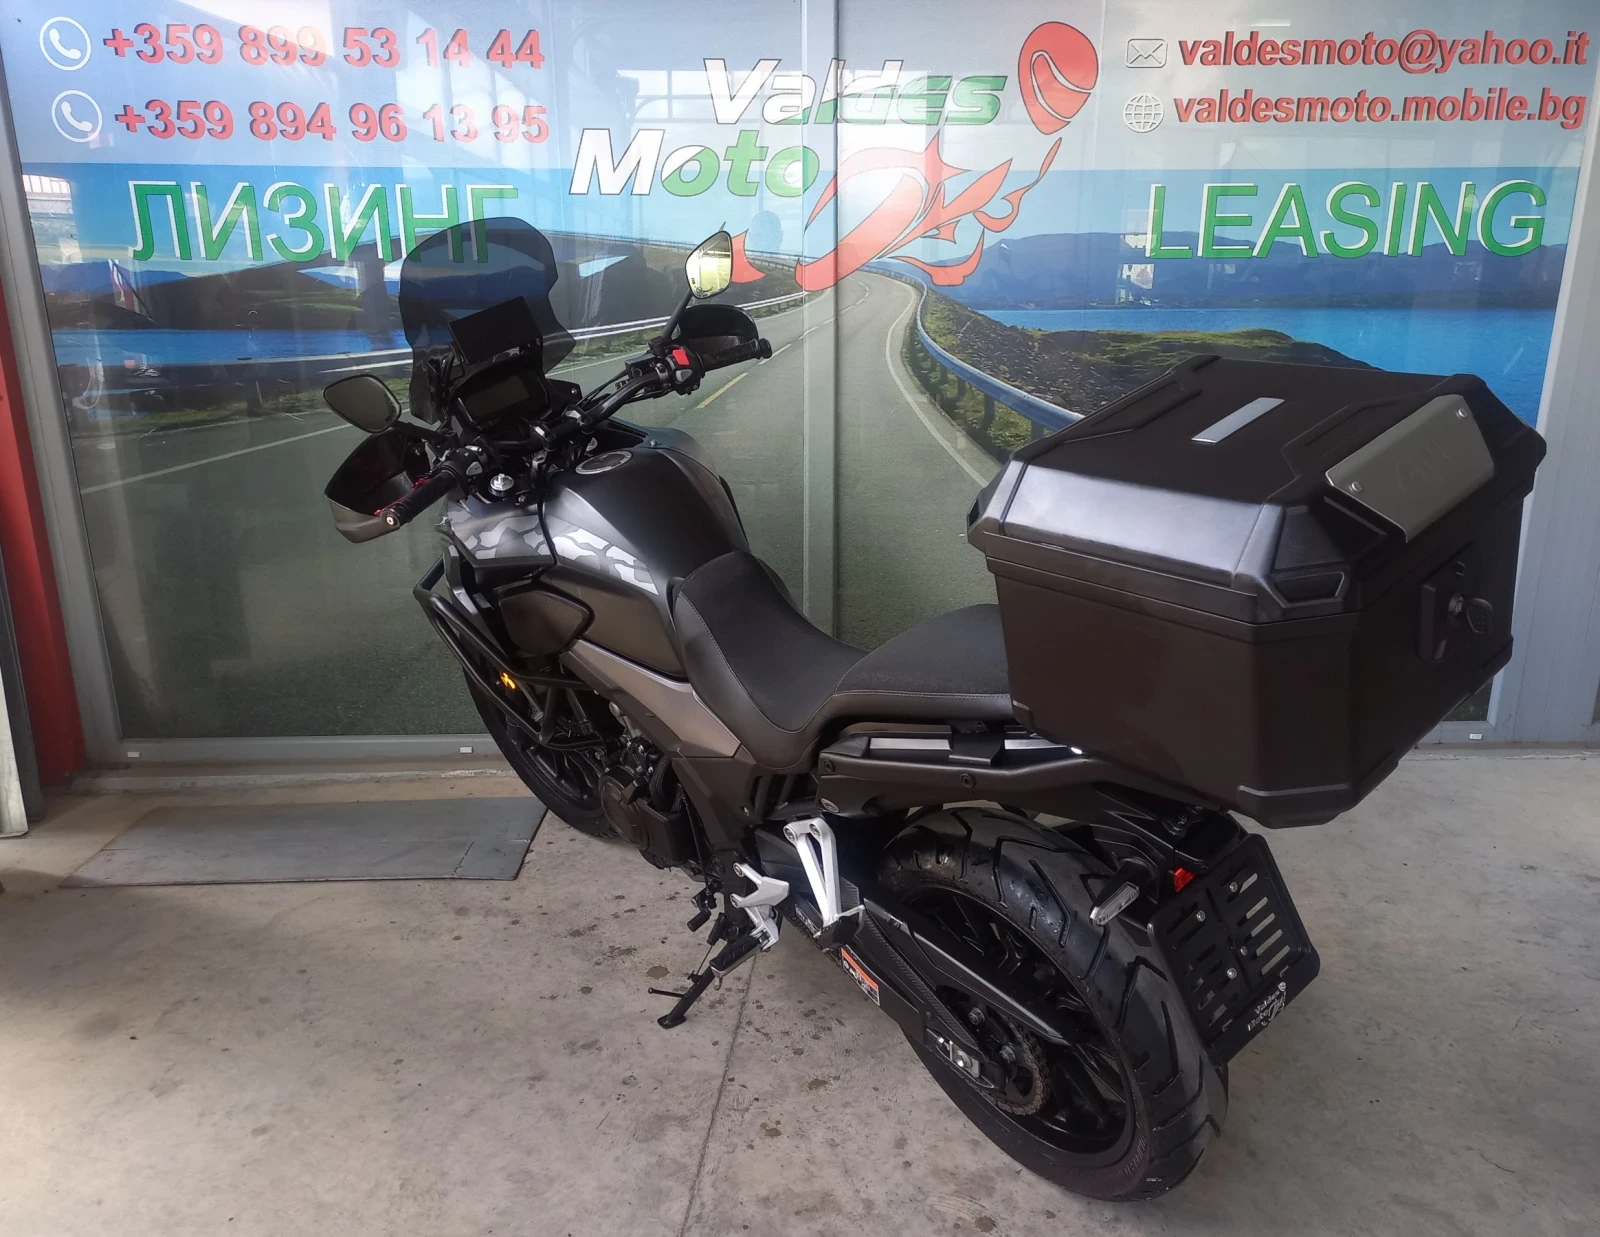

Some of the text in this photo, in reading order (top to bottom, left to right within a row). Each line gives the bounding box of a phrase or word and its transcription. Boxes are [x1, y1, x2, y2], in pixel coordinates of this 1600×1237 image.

[103, 23, 546, 70] +359 899 53 14 44
[1178, 29, 1590, 74] valdesmoto@yahoo.it
[702, 57, 1008, 126] Valdes
[1173, 87, 1587, 130] valdesmoto.mobile.bg
[115, 98, 550, 145] +359 894 96 13 95
[569, 128, 820, 198] Moto
[127, 180, 519, 264] ЛИЗИНГ
[1145, 179, 1547, 260] LEASING
